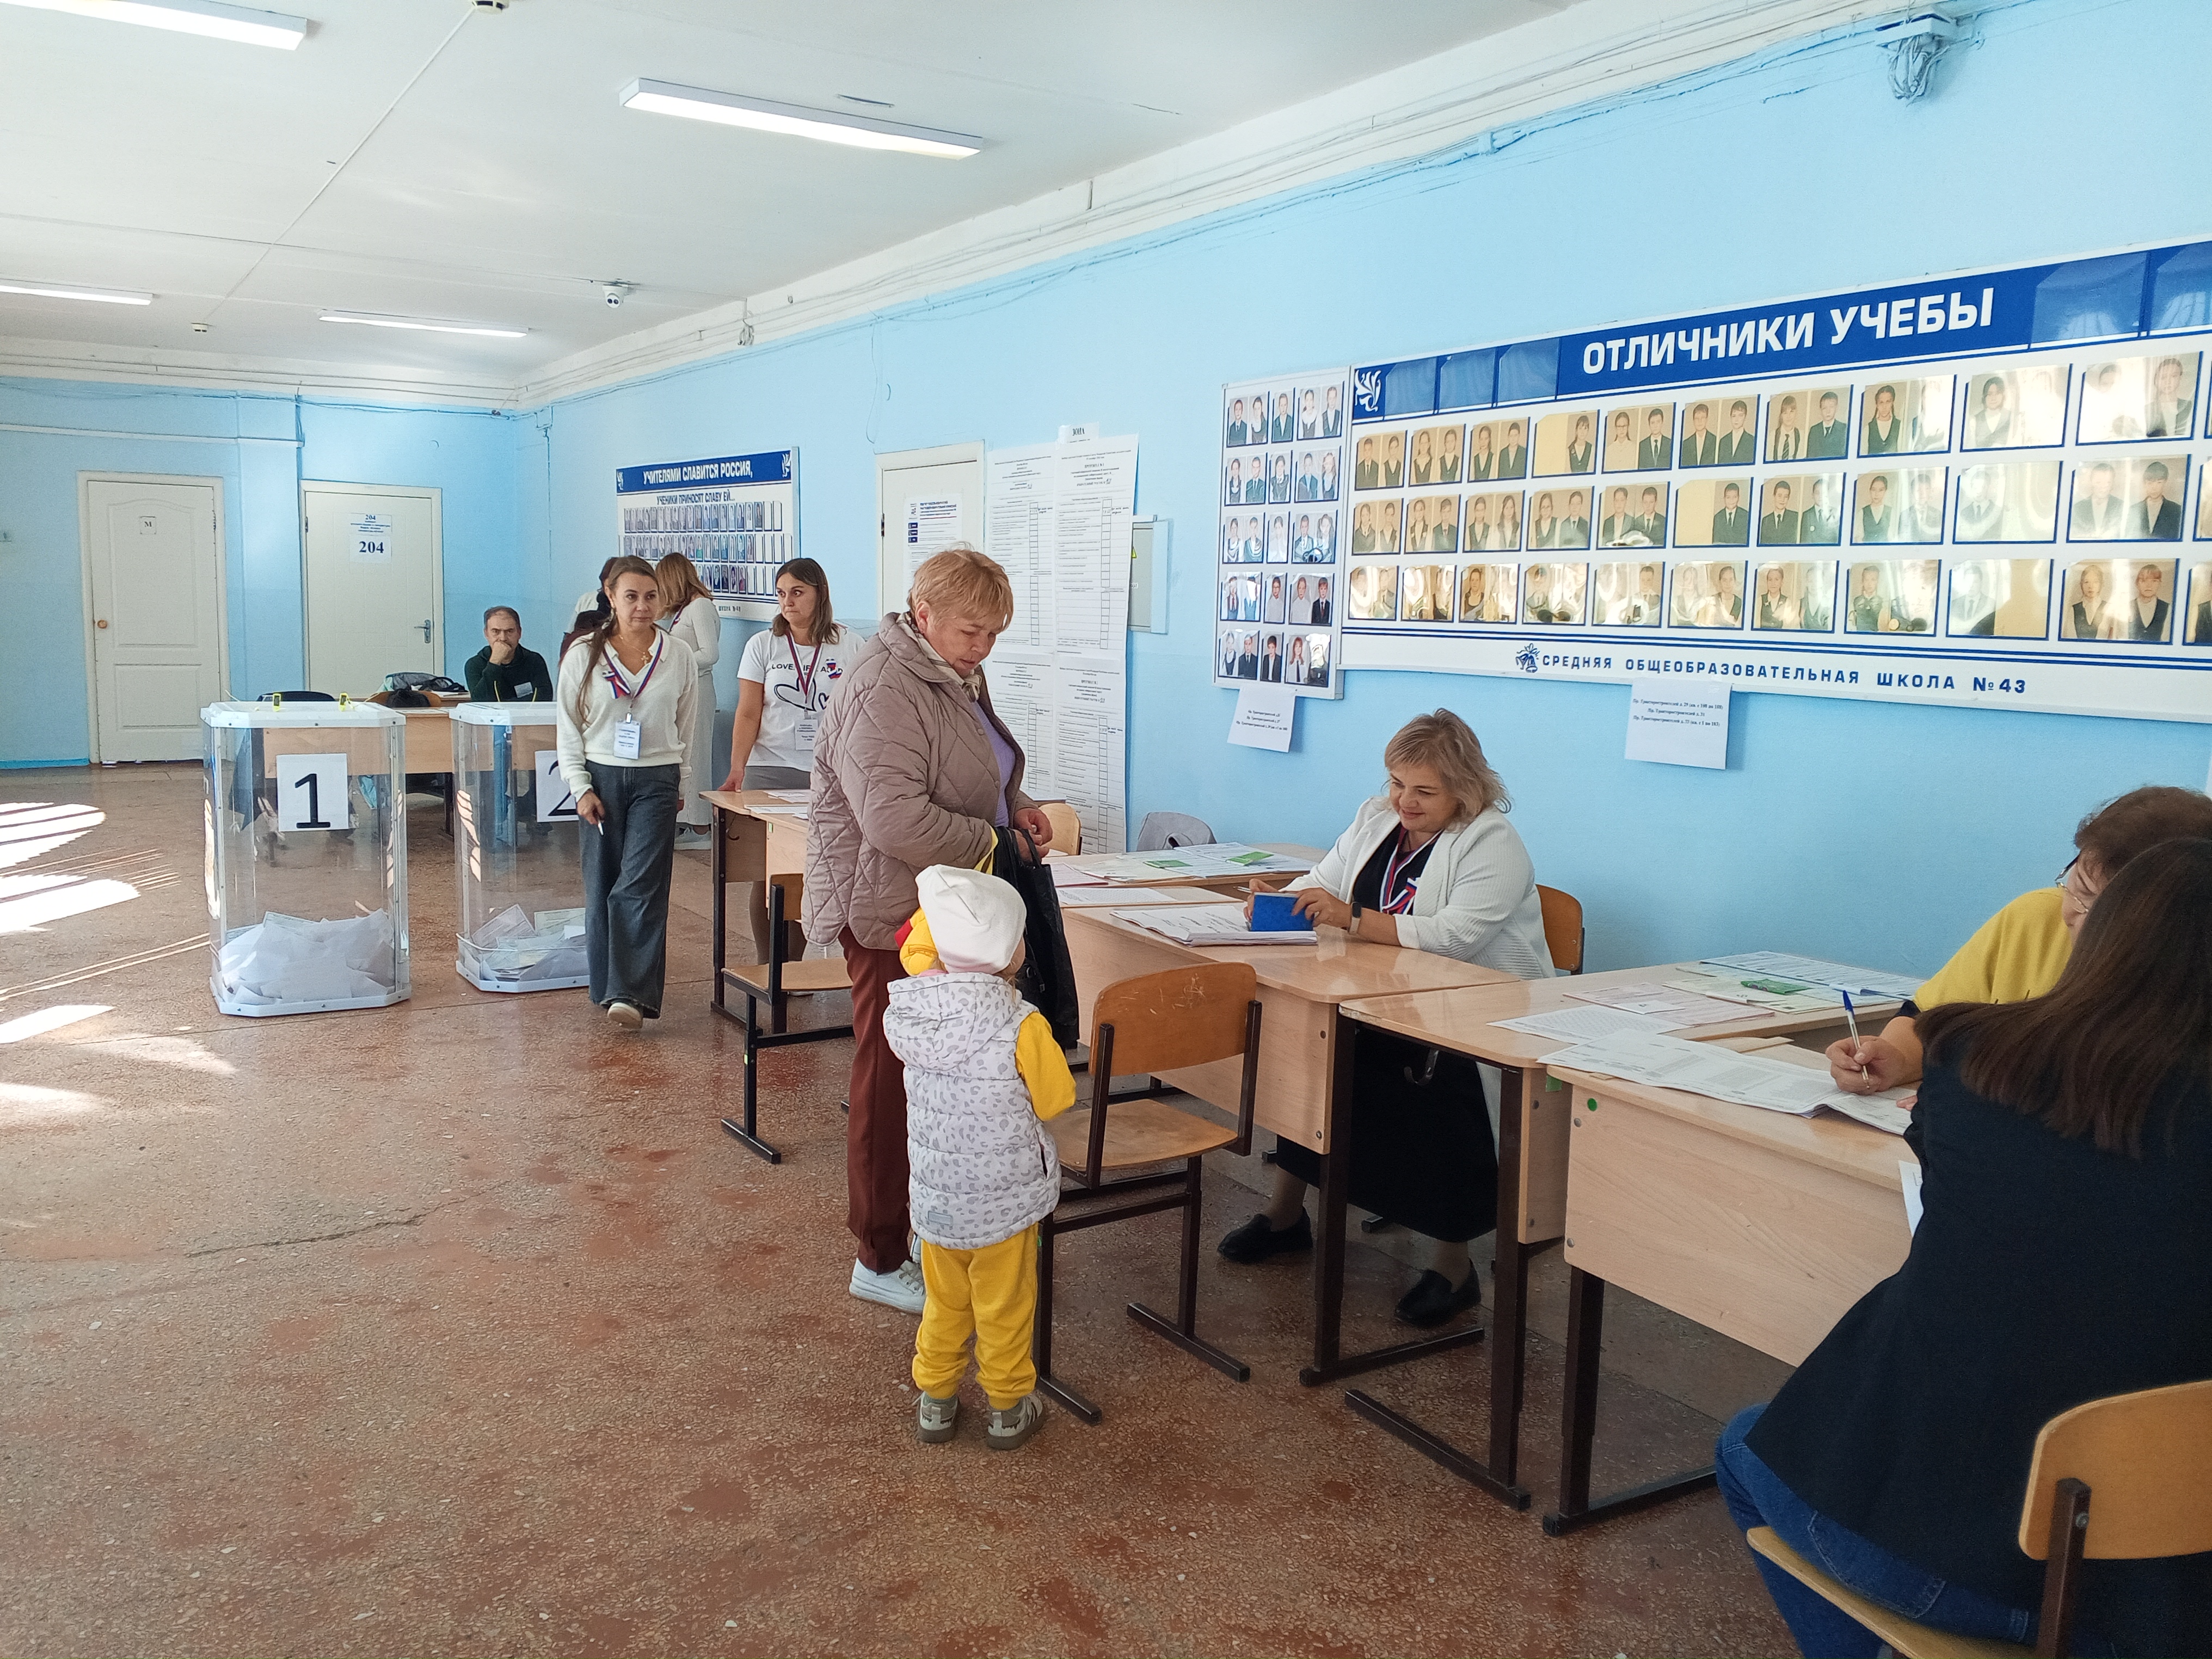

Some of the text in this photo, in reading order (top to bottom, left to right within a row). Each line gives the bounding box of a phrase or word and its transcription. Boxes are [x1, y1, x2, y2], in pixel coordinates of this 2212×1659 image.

[1582, 287, 1994, 374] ОТЛИЧНИКИ УЧЕБЫ
[643, 460, 753, 485] УЧИТЕЛЯМИ СЛАВИТСЯ РОССИЯ,
[359, 540, 384, 554] 204
[1542, 655, 1612, 669] СРЕДНЯЯ
[1625, 659, 1859, 684] ОБЩЕОБРАЗОВАТЕЛЬНАЯ
[1877, 672, 1956, 690] ШКОЛА
[294, 773, 331, 829] 1
